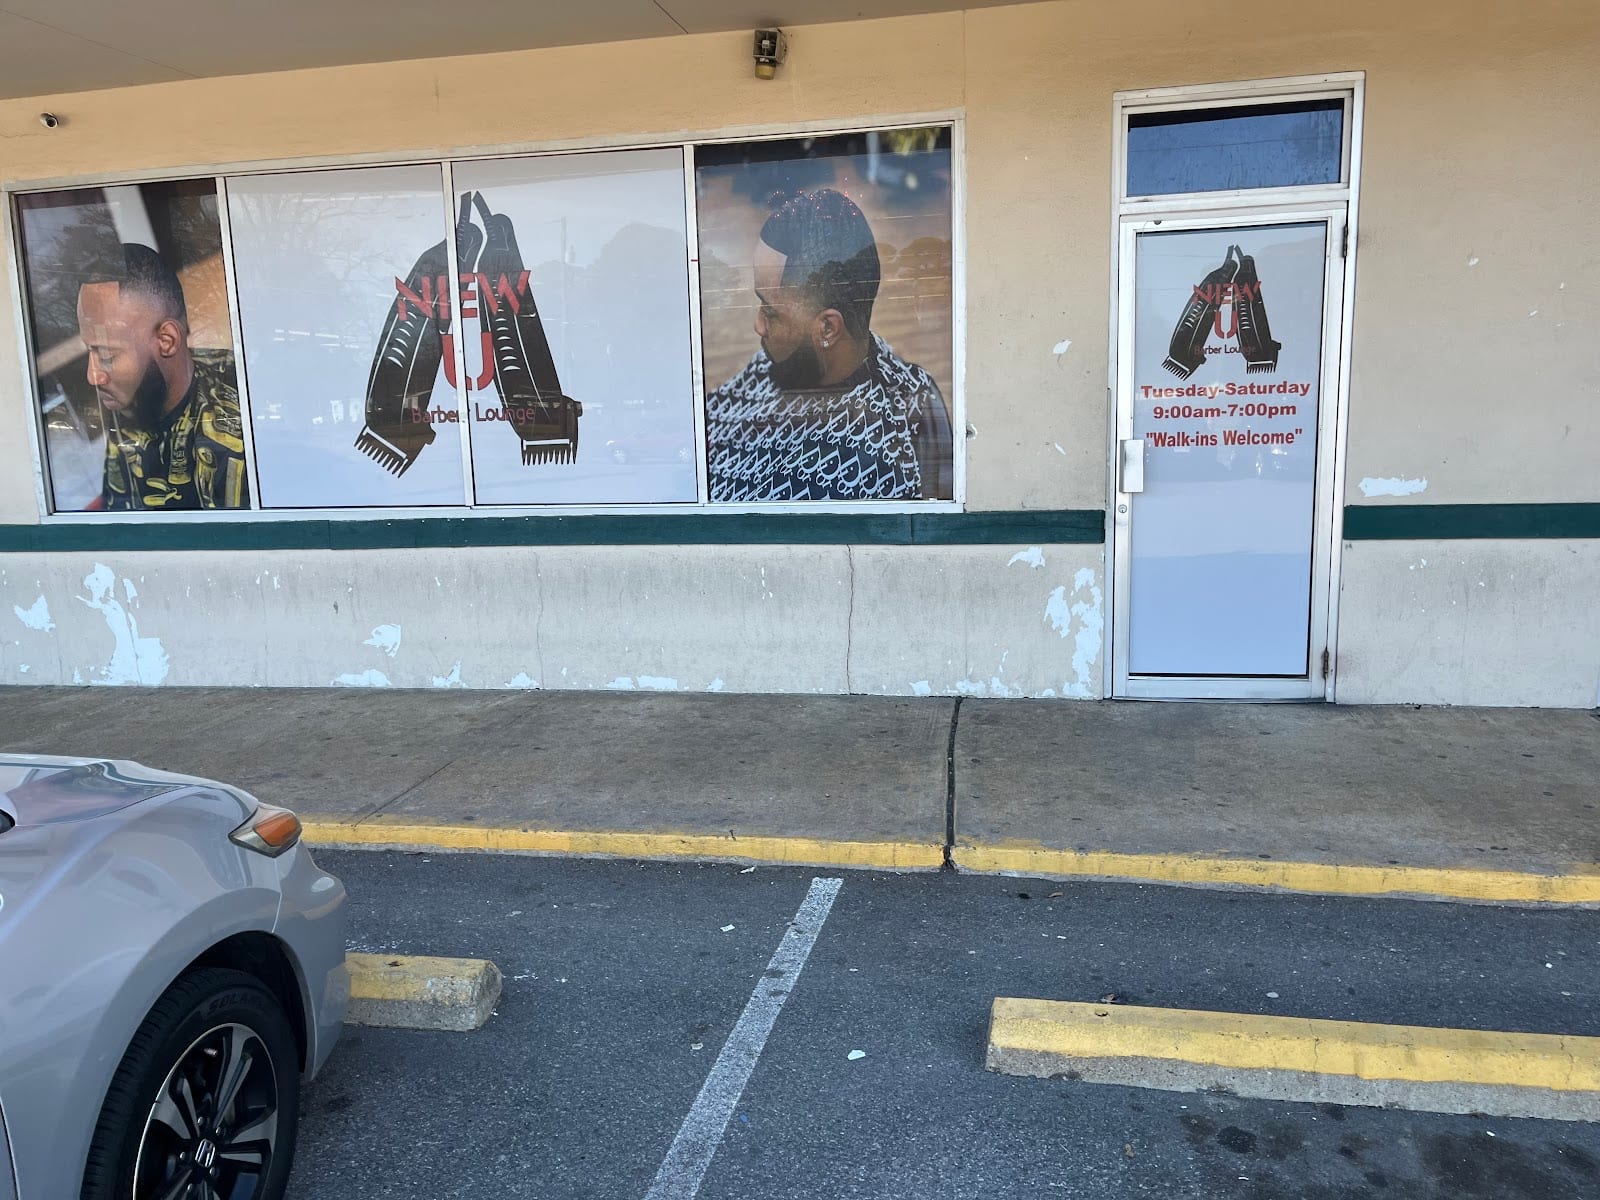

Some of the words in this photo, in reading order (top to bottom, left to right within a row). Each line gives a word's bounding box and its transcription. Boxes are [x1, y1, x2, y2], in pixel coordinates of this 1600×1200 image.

[395, 270, 531, 321] NEW
[1193, 281, 1261, 305] NEW
[1215, 310, 1238, 339] U
[442, 332, 495, 391] U
[1141, 380, 1311, 399] Tuesday-Saturday
[475, 402, 536, 426] Lounge
[1153, 403, 1297, 419] 9:00am-7:00pm
[1146, 431, 1218, 448] "Walk-ins
[1223, 428, 1303, 445] Welcome"
